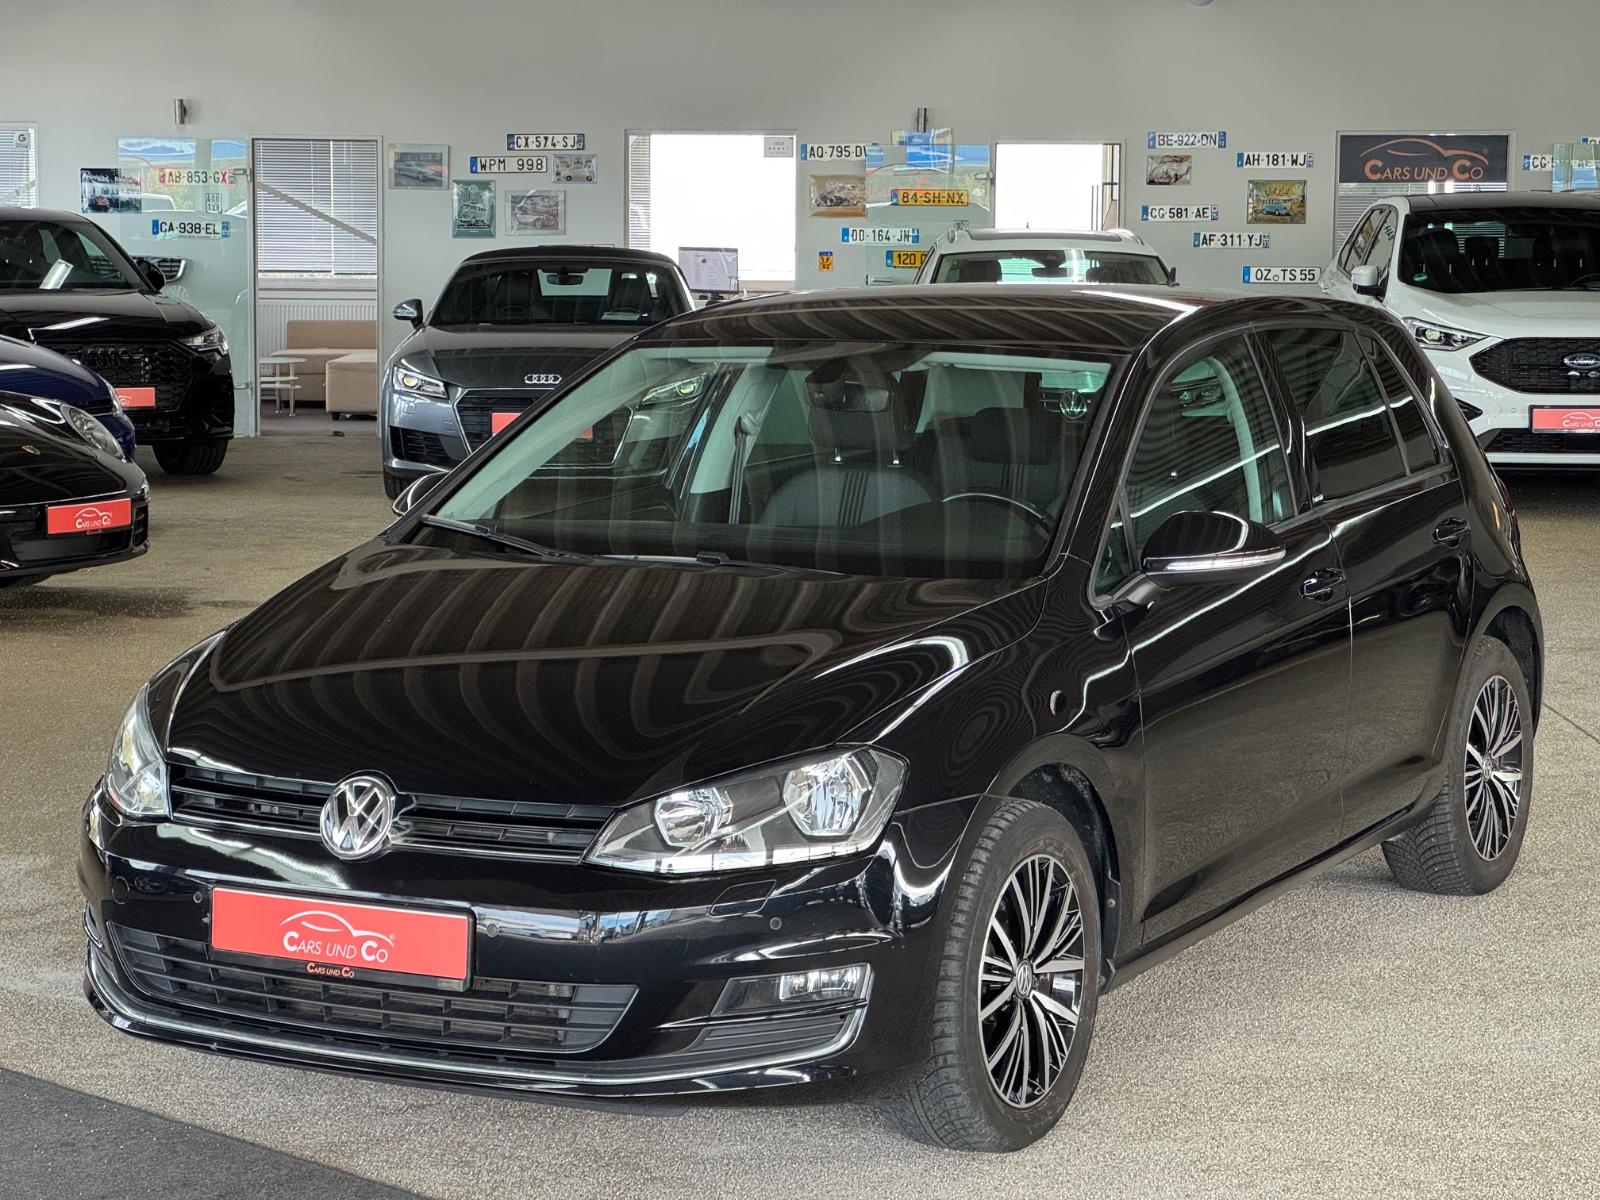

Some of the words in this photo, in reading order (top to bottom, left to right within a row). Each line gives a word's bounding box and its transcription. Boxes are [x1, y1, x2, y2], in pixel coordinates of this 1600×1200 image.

[515, 136, 576, 148] CX-574-SJ
[1157, 134, 1217, 146] BE-922-DN
[479, 158, 506, 171] WPM
[516, 158, 544, 171] 998
[1244, 153, 1306, 166] AH-181-WJ
[901, 191, 964, 204] 84-SH-NX
[1150, 207, 1210, 219] CG-581-AE
[160, 221, 220, 234] CA-938-EL
[1201, 233, 1262, 247] AF-311-YJ
[897, 253, 916, 265] 120
[1282, 268, 1297, 281] TS
[1300, 269, 1316, 281] 55
[326, 942, 358, 959] UND
